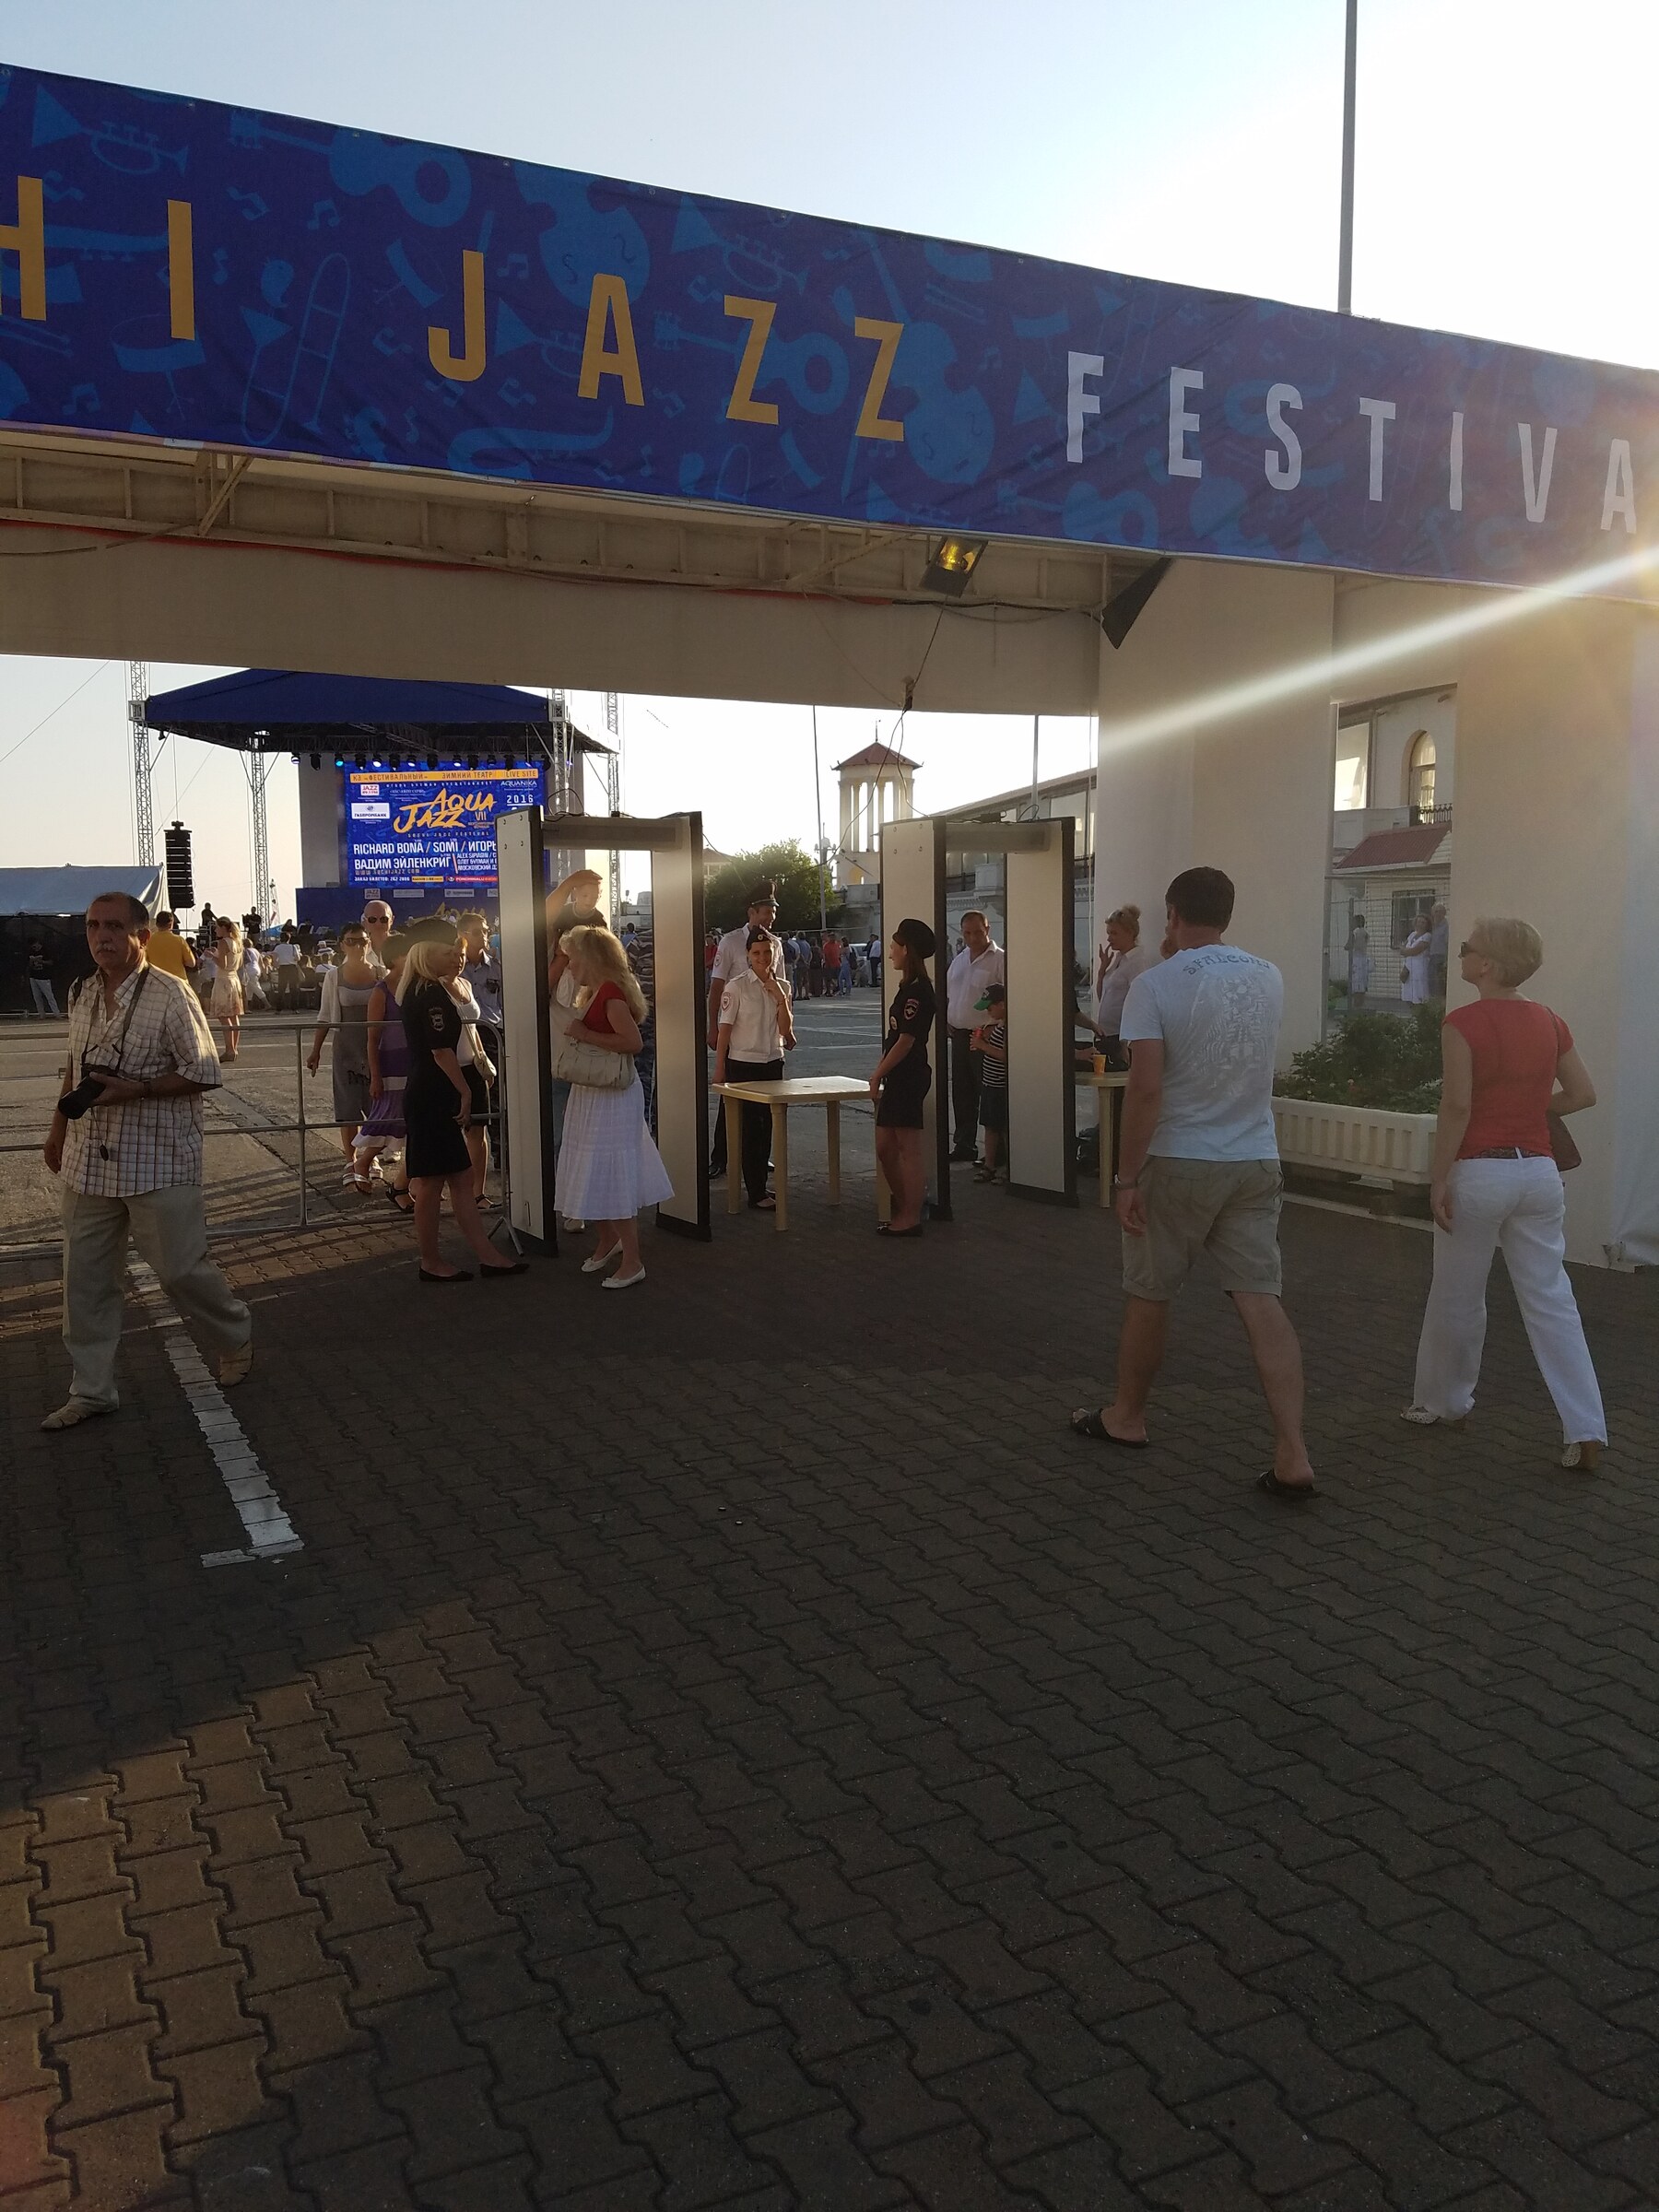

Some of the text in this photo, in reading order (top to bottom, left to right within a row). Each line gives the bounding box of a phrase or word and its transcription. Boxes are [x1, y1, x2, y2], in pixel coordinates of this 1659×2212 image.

[428, 249, 905, 441] JAZZ
[1066, 351, 1636, 534] FESTIVA
[429, 787, 497, 812] AQUA
[507, 794, 534, 803] 2016
[394, 803, 466, 833] JAZZ
[475, 811, 487, 820] VII
[353, 843, 394, 854] RICHARD
[396, 842, 424, 853] BONA
[432, 841, 459, 853] SOMI
[354, 856, 452, 870] ВАДИМ ЭЙЛЕНКРИГ
